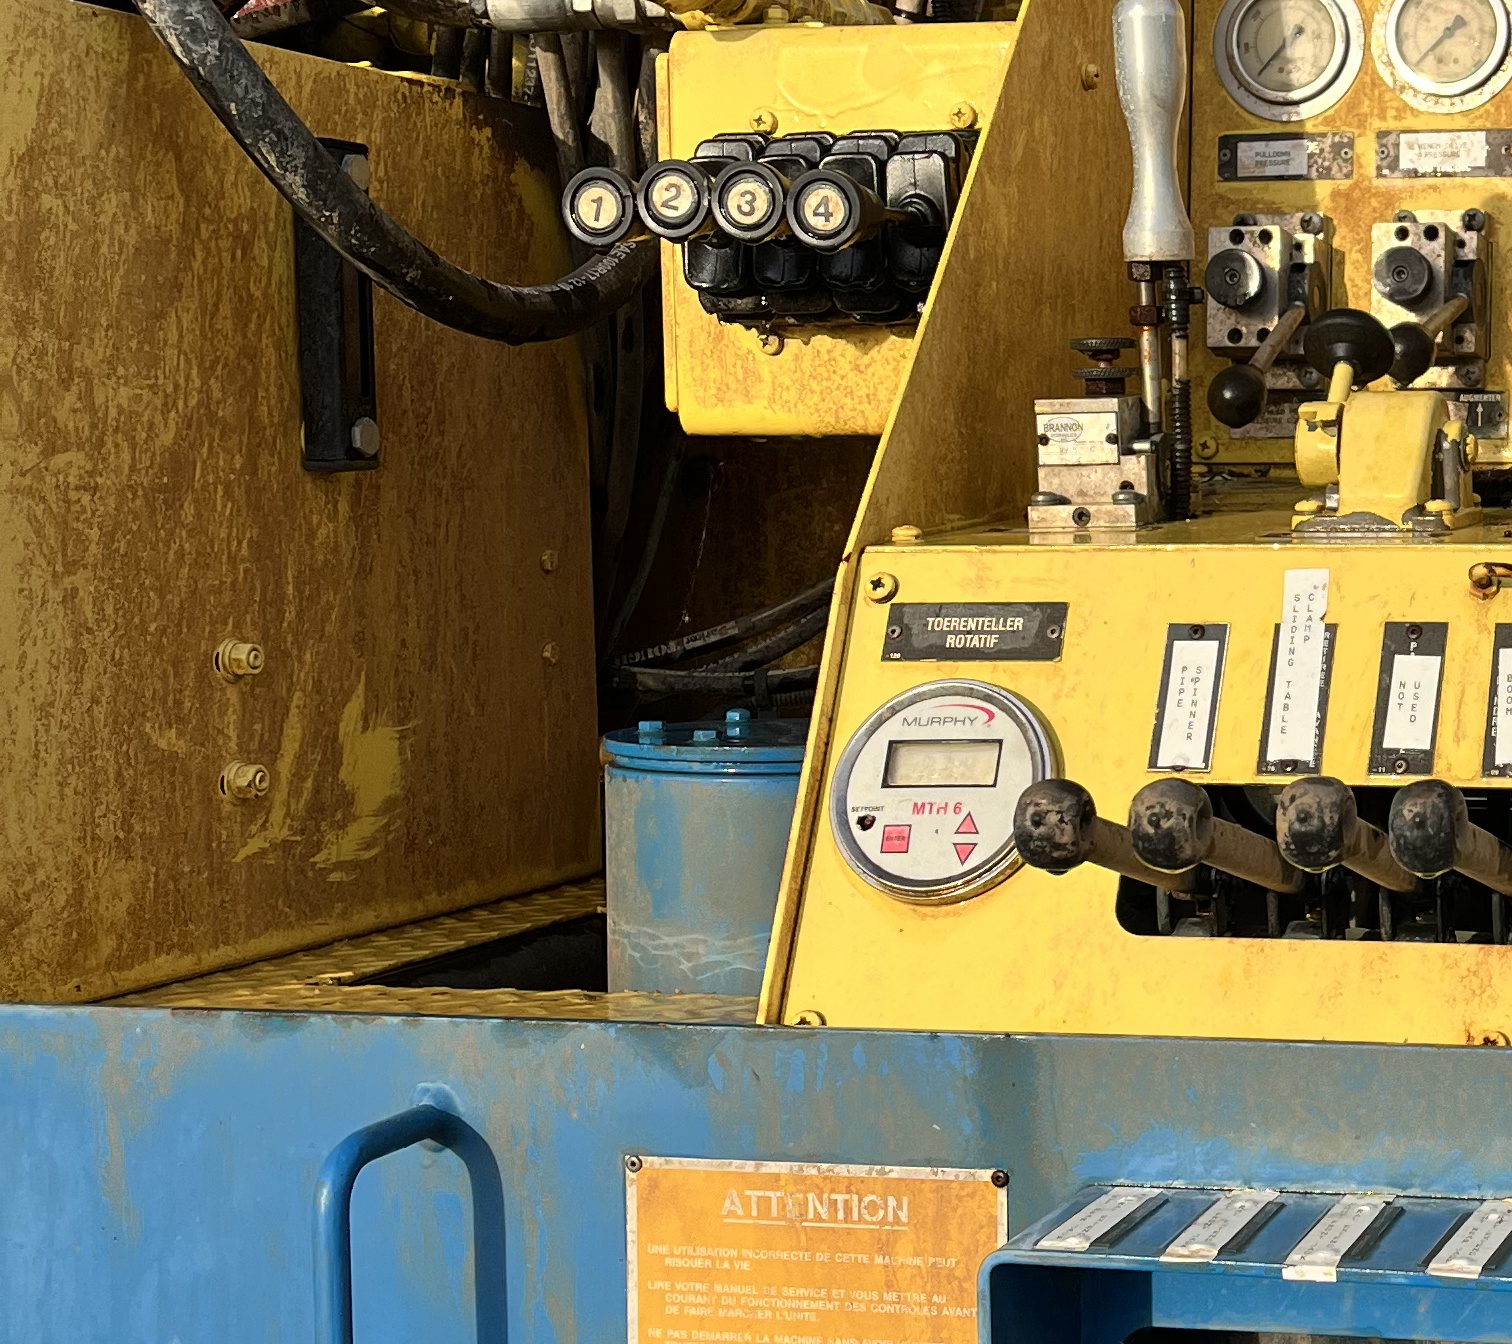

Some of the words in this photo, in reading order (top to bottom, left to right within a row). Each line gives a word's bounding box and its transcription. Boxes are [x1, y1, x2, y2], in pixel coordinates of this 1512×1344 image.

[590, 196, 606, 223] 1
[660, 183, 682, 211] 2
[738, 190, 757, 216] 3
[812, 196, 834, 223] 4
[1044, 423, 1084, 433] BRANNON
[926, 617, 1024, 631] TOERENTELLER
[1287, 594, 1300, 666] SLIDING
[945, 634, 999, 648] ROTATIF
[1176, 665, 1188, 707] PIPE
[1396, 681, 1406, 711] NOT
[1186, 665, 1202, 742] SPINNER
[1280, 680, 1292, 734] TABLE
[1409, 681, 1421, 723] USED
[902, 716, 979, 727] MURPHY
[911, 802, 949, 816] MTH
[953, 802, 963, 815] 6
[721, 1188, 909, 1224] ATTENTION
